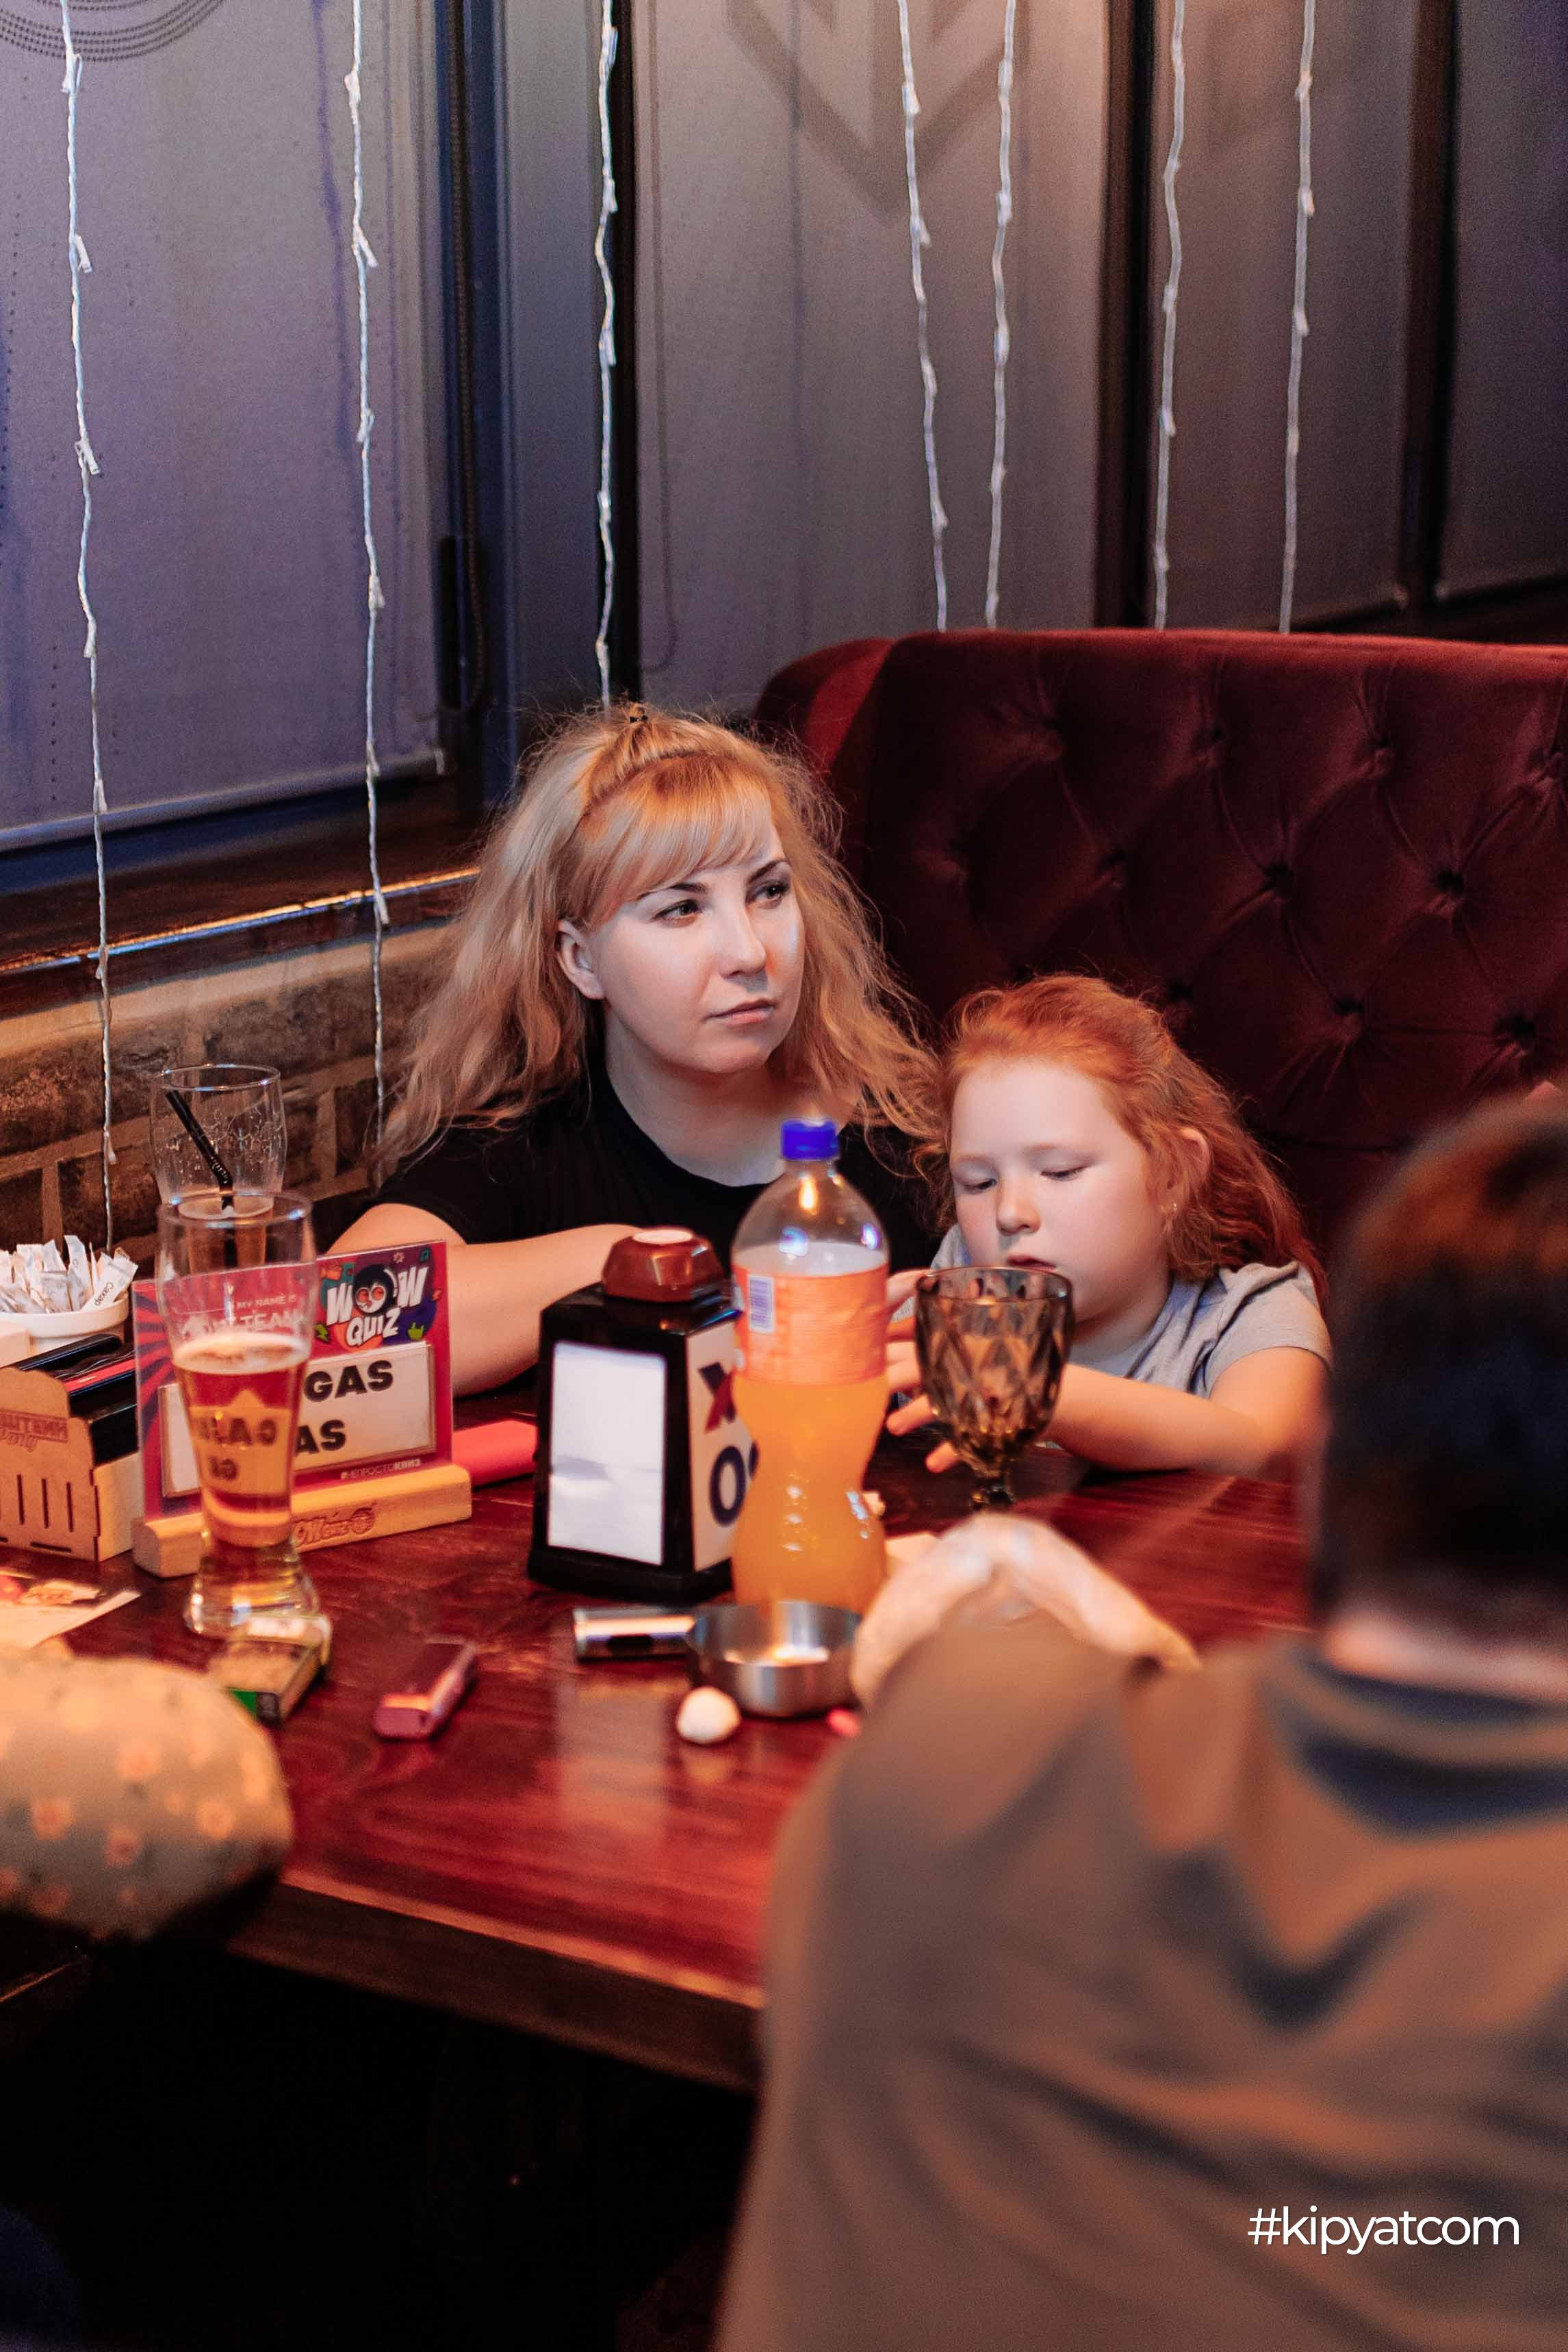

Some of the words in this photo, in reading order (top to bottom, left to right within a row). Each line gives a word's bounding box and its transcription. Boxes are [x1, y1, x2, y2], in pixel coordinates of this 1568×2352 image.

[326, 1266, 429, 1326] WOW
[346, 1307, 401, 1346] QUIZ
[304, 1359, 394, 1403] GAS
[294, 1419, 346, 1456] AS
